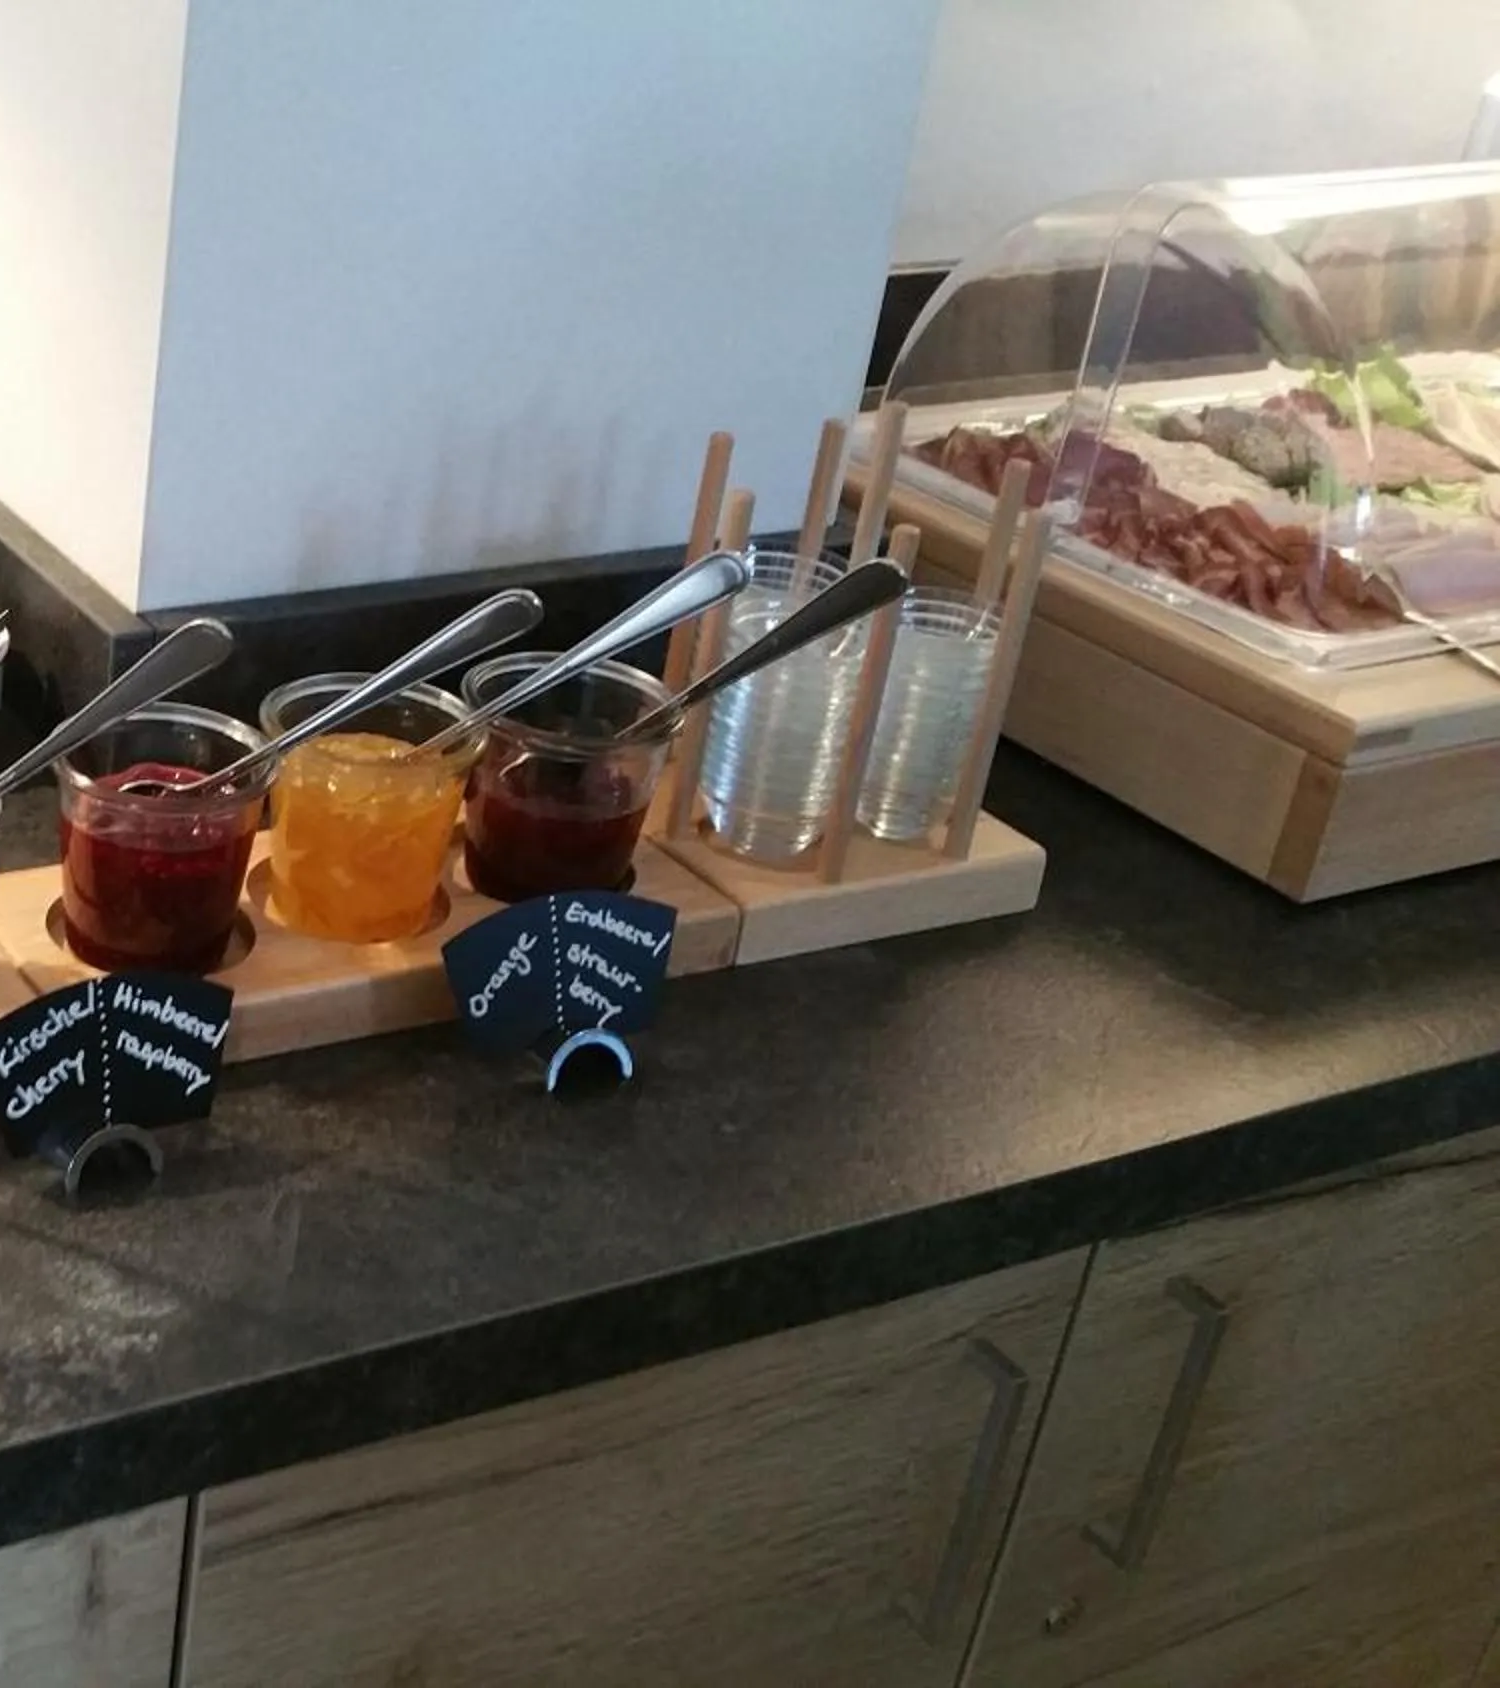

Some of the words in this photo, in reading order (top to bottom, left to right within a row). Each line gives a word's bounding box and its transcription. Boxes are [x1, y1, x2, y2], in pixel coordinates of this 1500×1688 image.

[565, 901, 671, 957] Erdbeere/
[469, 932, 538, 1017] Orange
[569, 974, 623, 1028] berry
[113, 981, 229, 1049] Himbeere/
[6, 1049, 85, 1120] cherry
